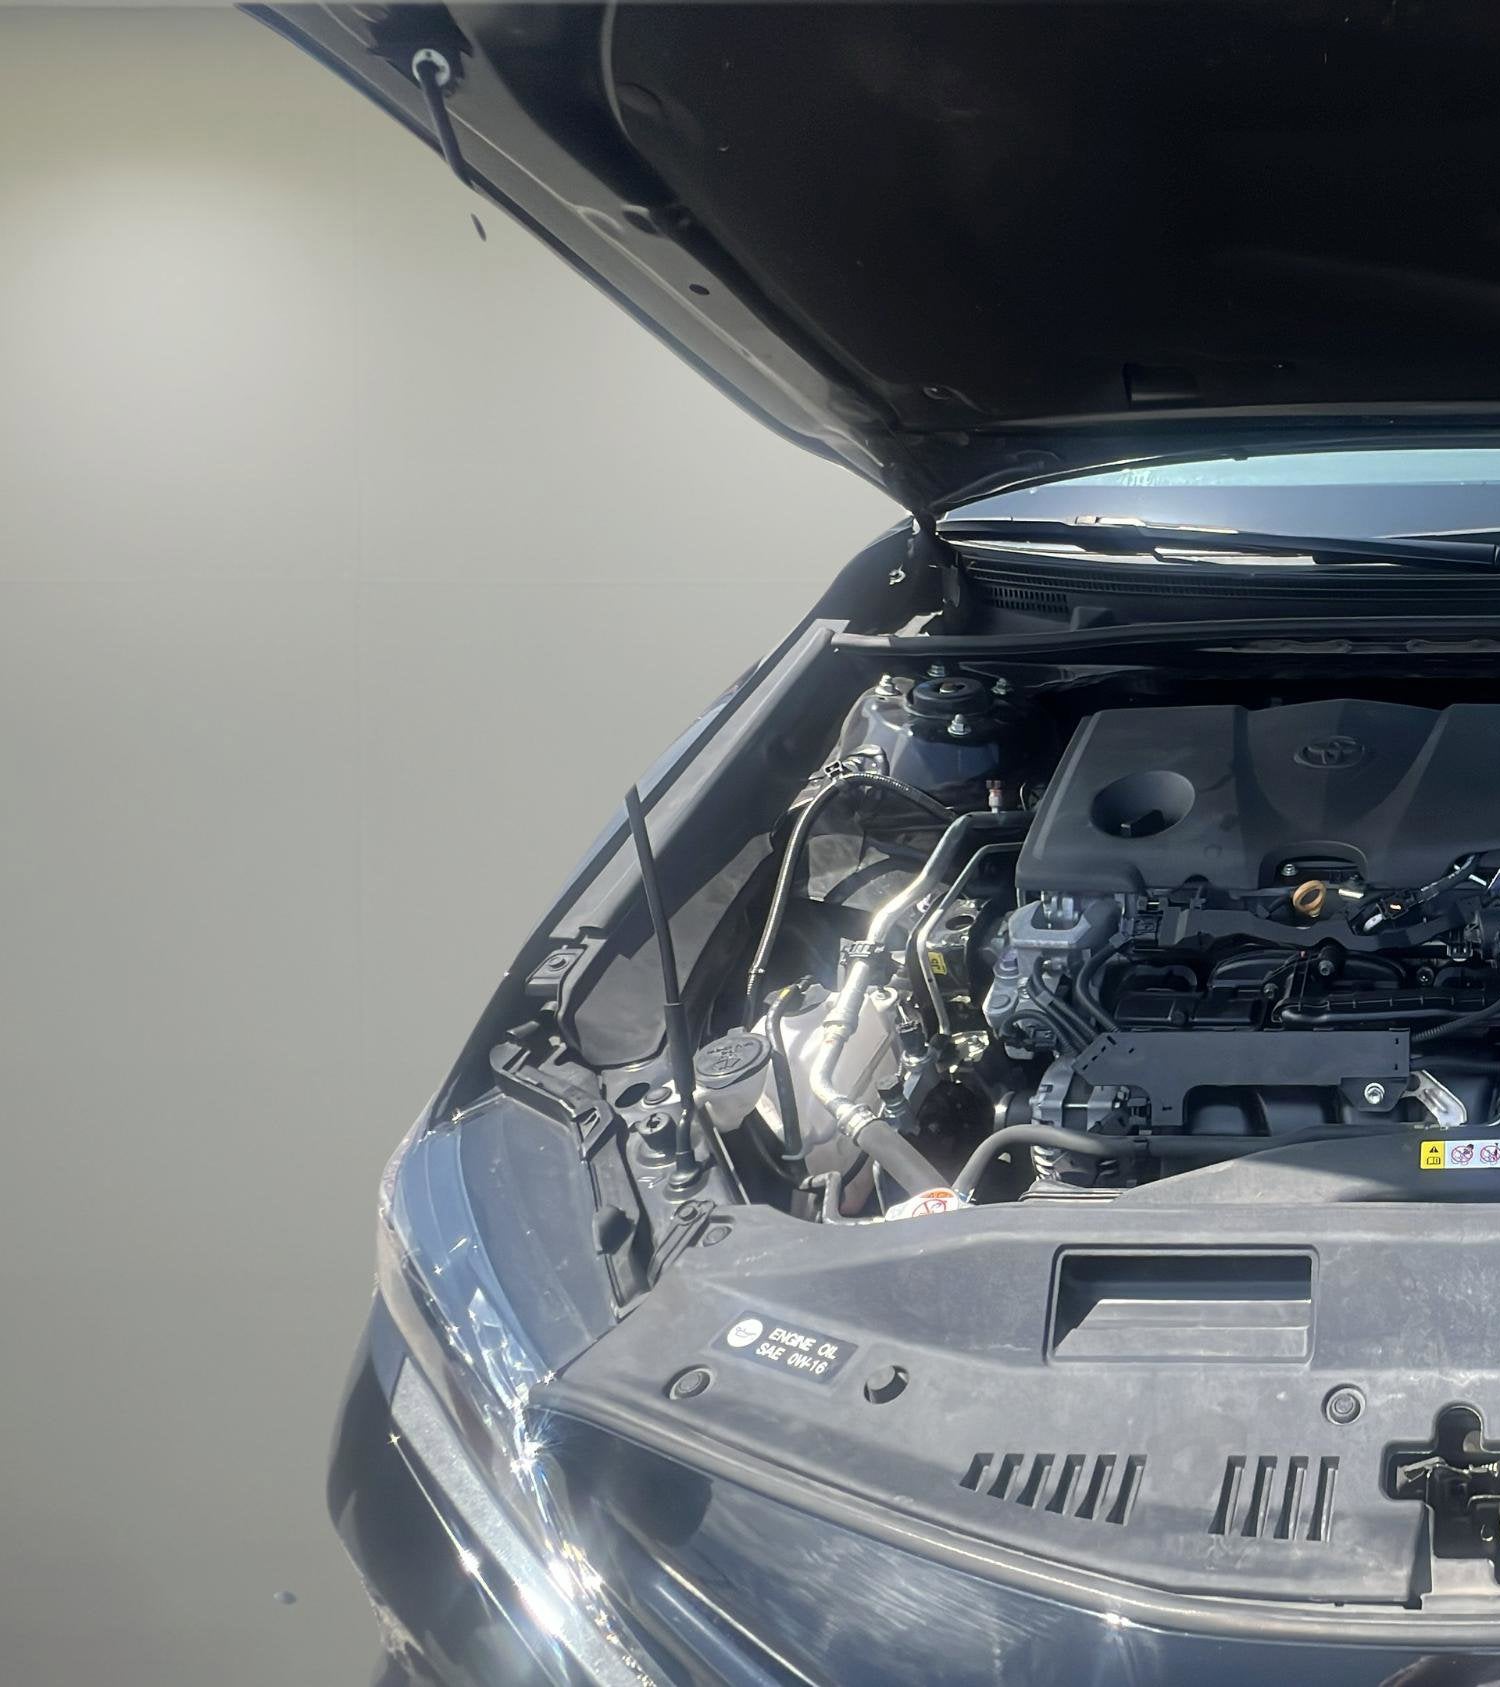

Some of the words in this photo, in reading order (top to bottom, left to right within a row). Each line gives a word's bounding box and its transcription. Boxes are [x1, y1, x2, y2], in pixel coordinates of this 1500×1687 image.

[755, 1342, 786, 1361] SAE
[786, 1352, 828, 1375] 0W-16
[768, 1327, 817, 1351] ENGINE
[817, 1343, 838, 1360] OIL
